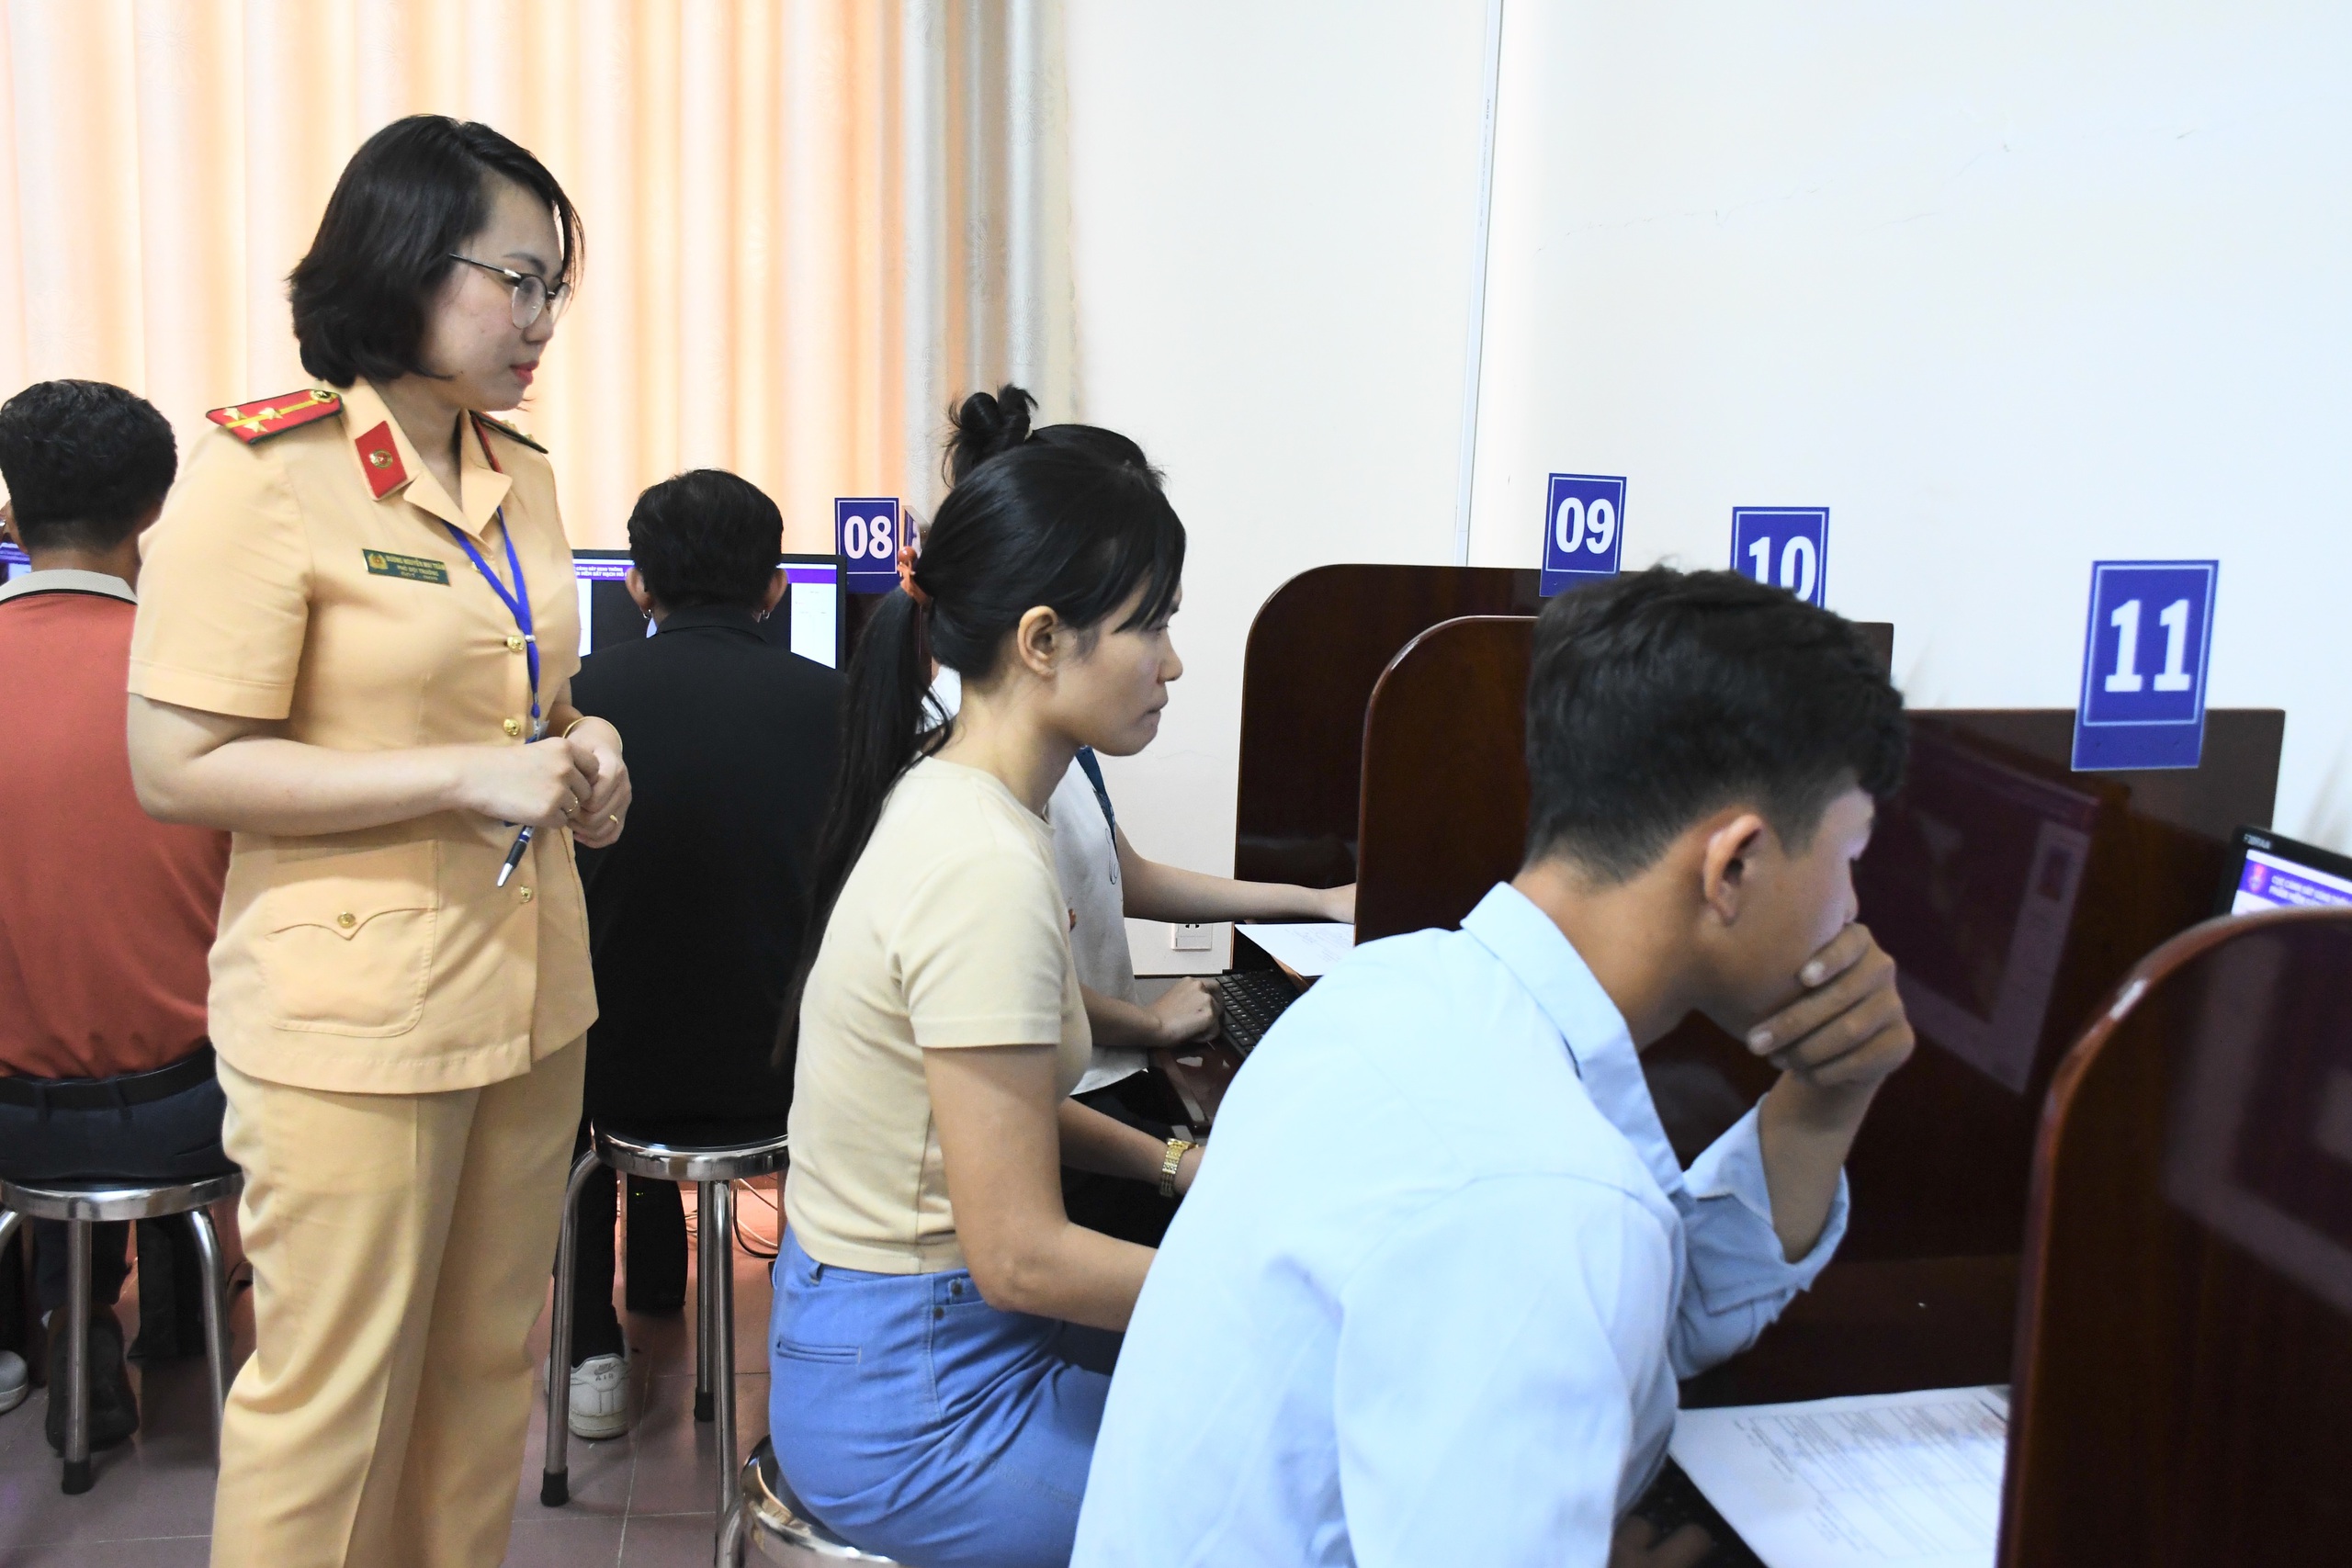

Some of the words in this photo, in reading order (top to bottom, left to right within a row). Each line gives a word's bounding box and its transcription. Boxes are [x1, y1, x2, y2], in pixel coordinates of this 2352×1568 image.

[844, 515, 893, 559] 08
[1555, 497, 1615, 554] 09
[1748, 536, 1816, 602] 10
[2104, 599, 2191, 693] 11
